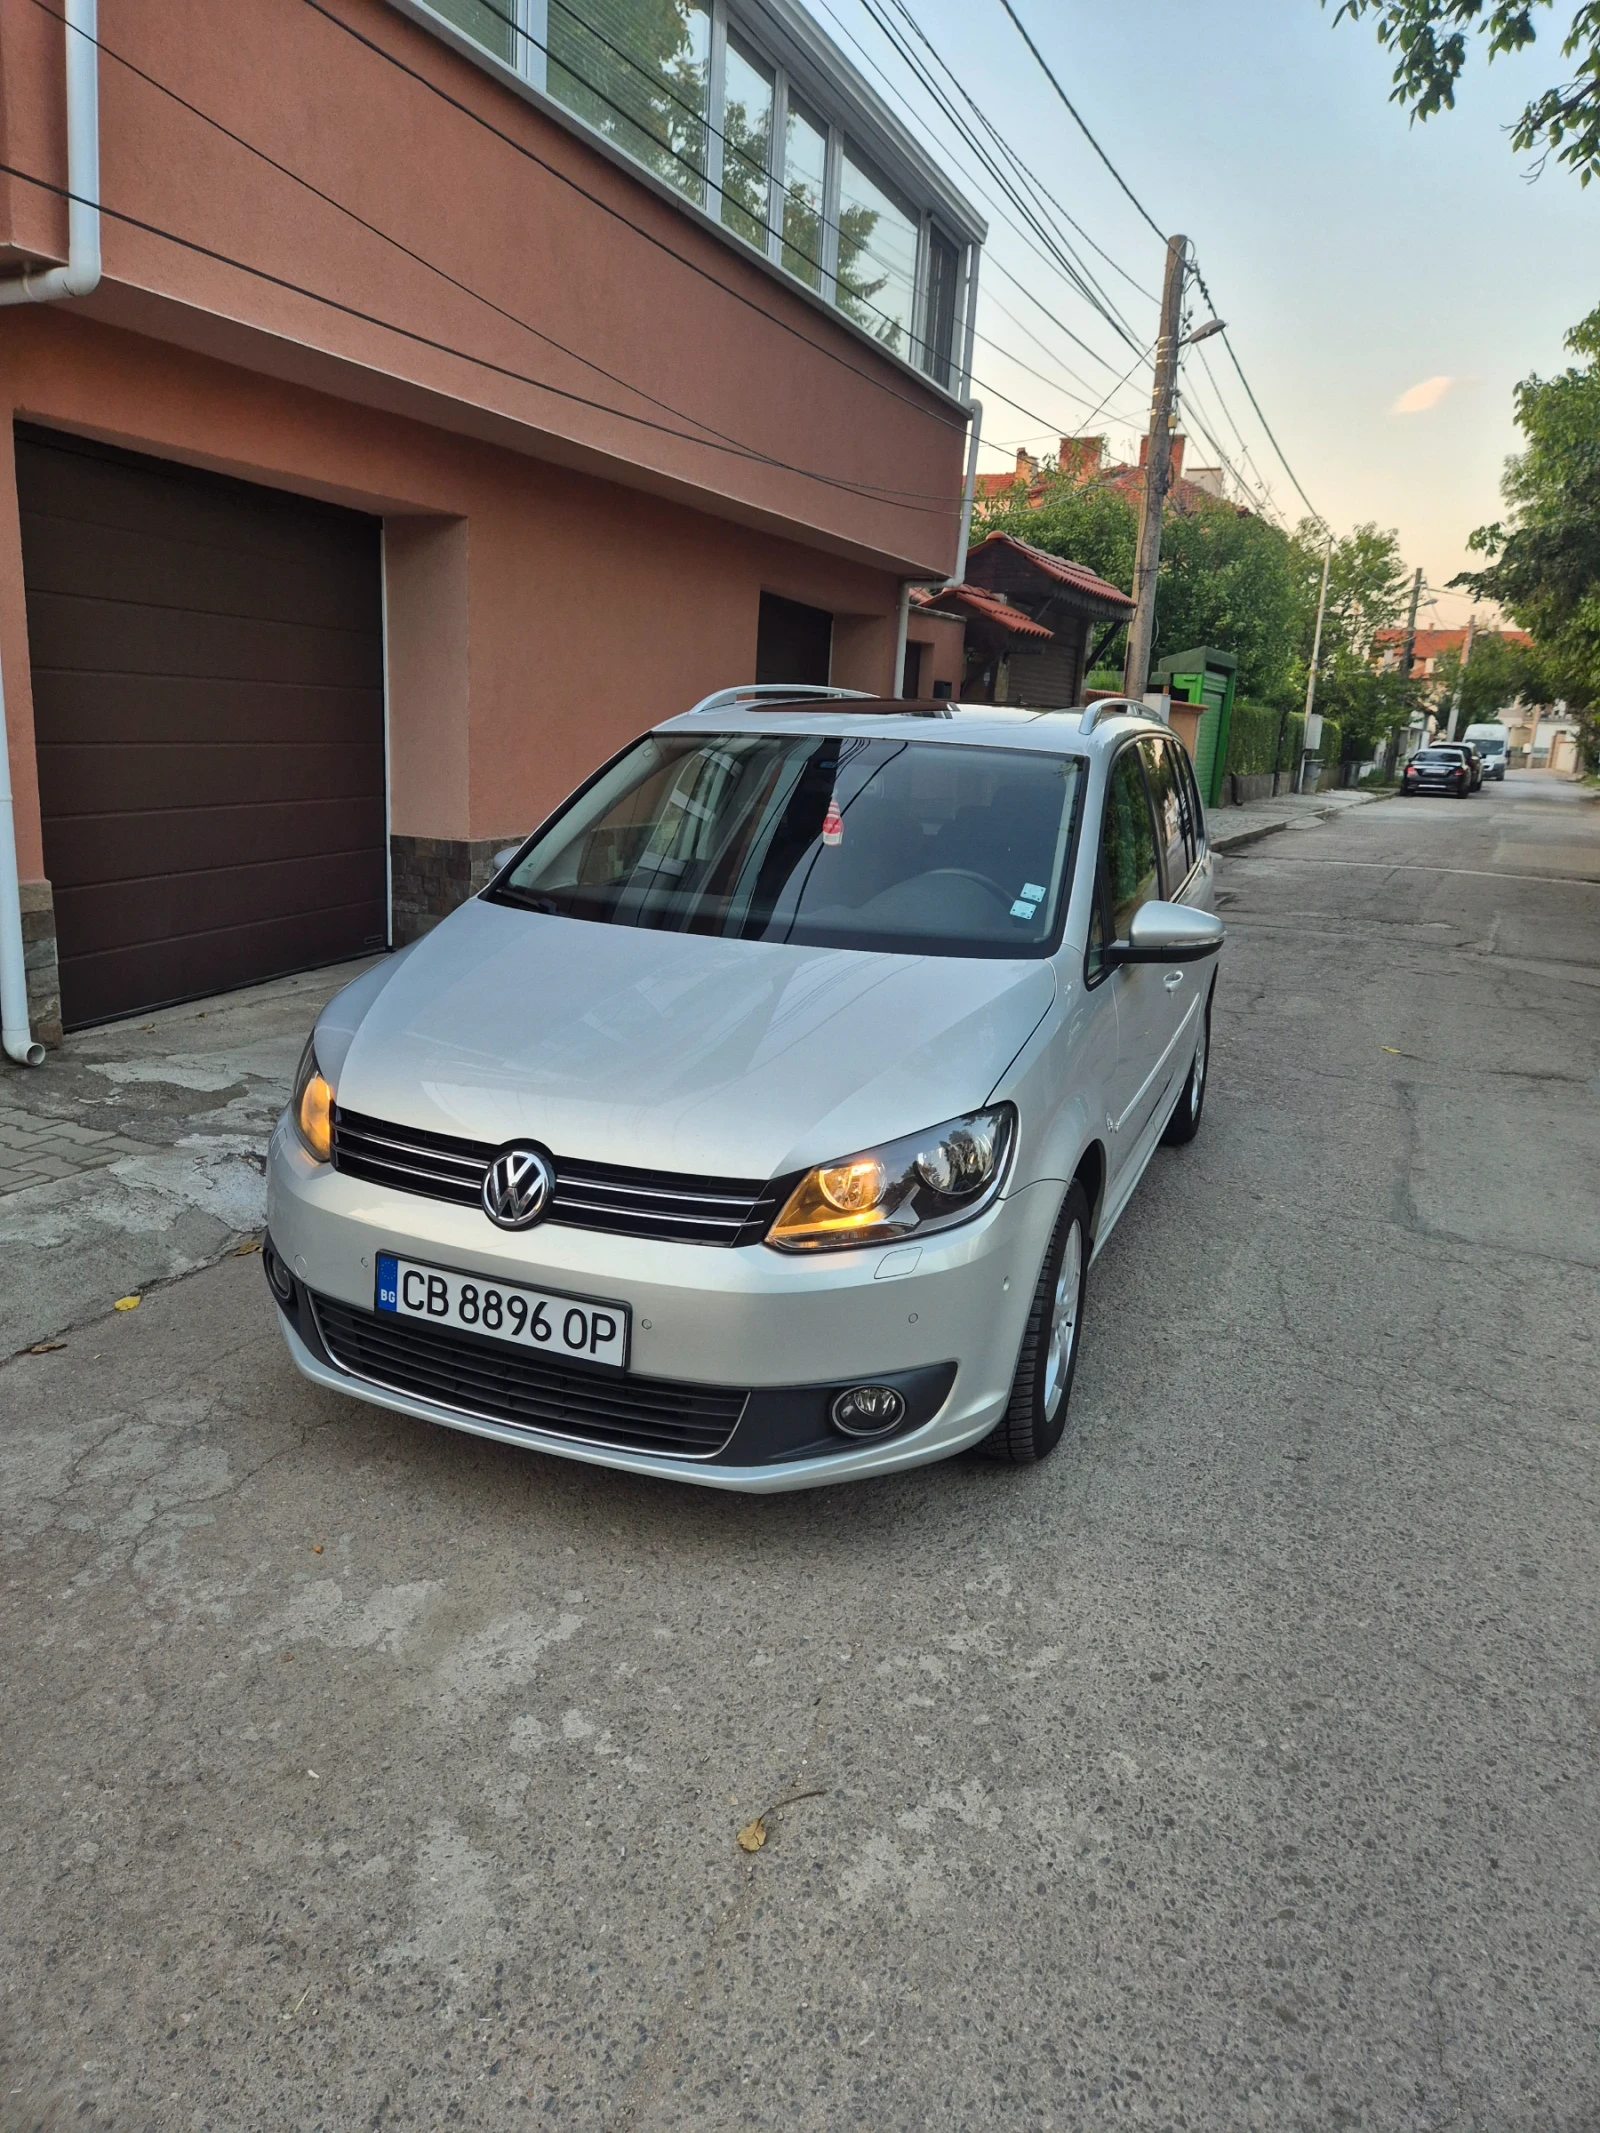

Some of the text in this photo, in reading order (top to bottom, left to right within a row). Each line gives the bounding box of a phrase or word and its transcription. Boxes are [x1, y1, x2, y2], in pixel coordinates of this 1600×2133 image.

[489, 1151, 548, 1222] VW
[380, 1288, 396, 1303] BG
[402, 1270, 617, 1354] CB 8896 OP
